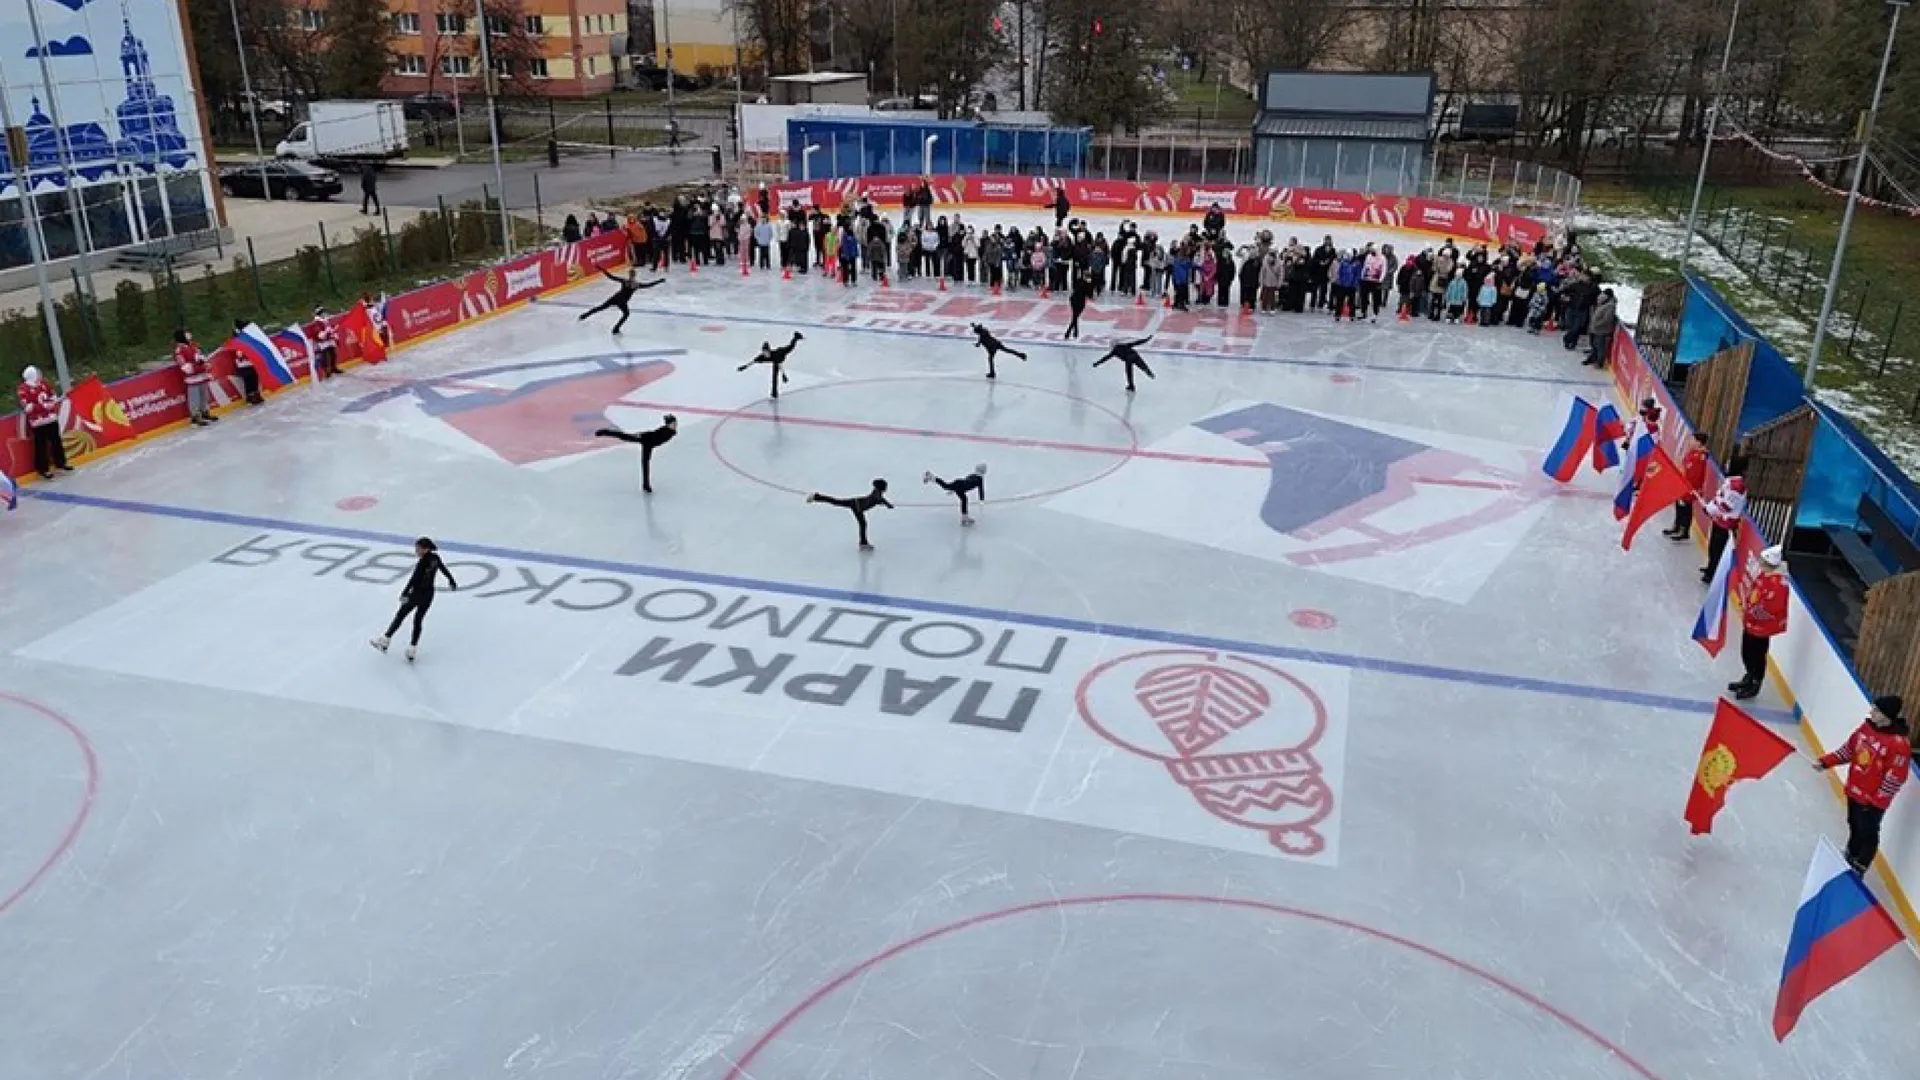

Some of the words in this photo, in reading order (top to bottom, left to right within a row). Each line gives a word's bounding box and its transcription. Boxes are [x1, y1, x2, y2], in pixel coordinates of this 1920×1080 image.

[845, 291, 1258, 339] ЗИМА
[865, 317, 1253, 354] ПОДОСКВЬЕ
[211, 533, 1068, 675] ПОДМОСКОВЬЯ
[613, 636, 1042, 733] ПАРКИ
